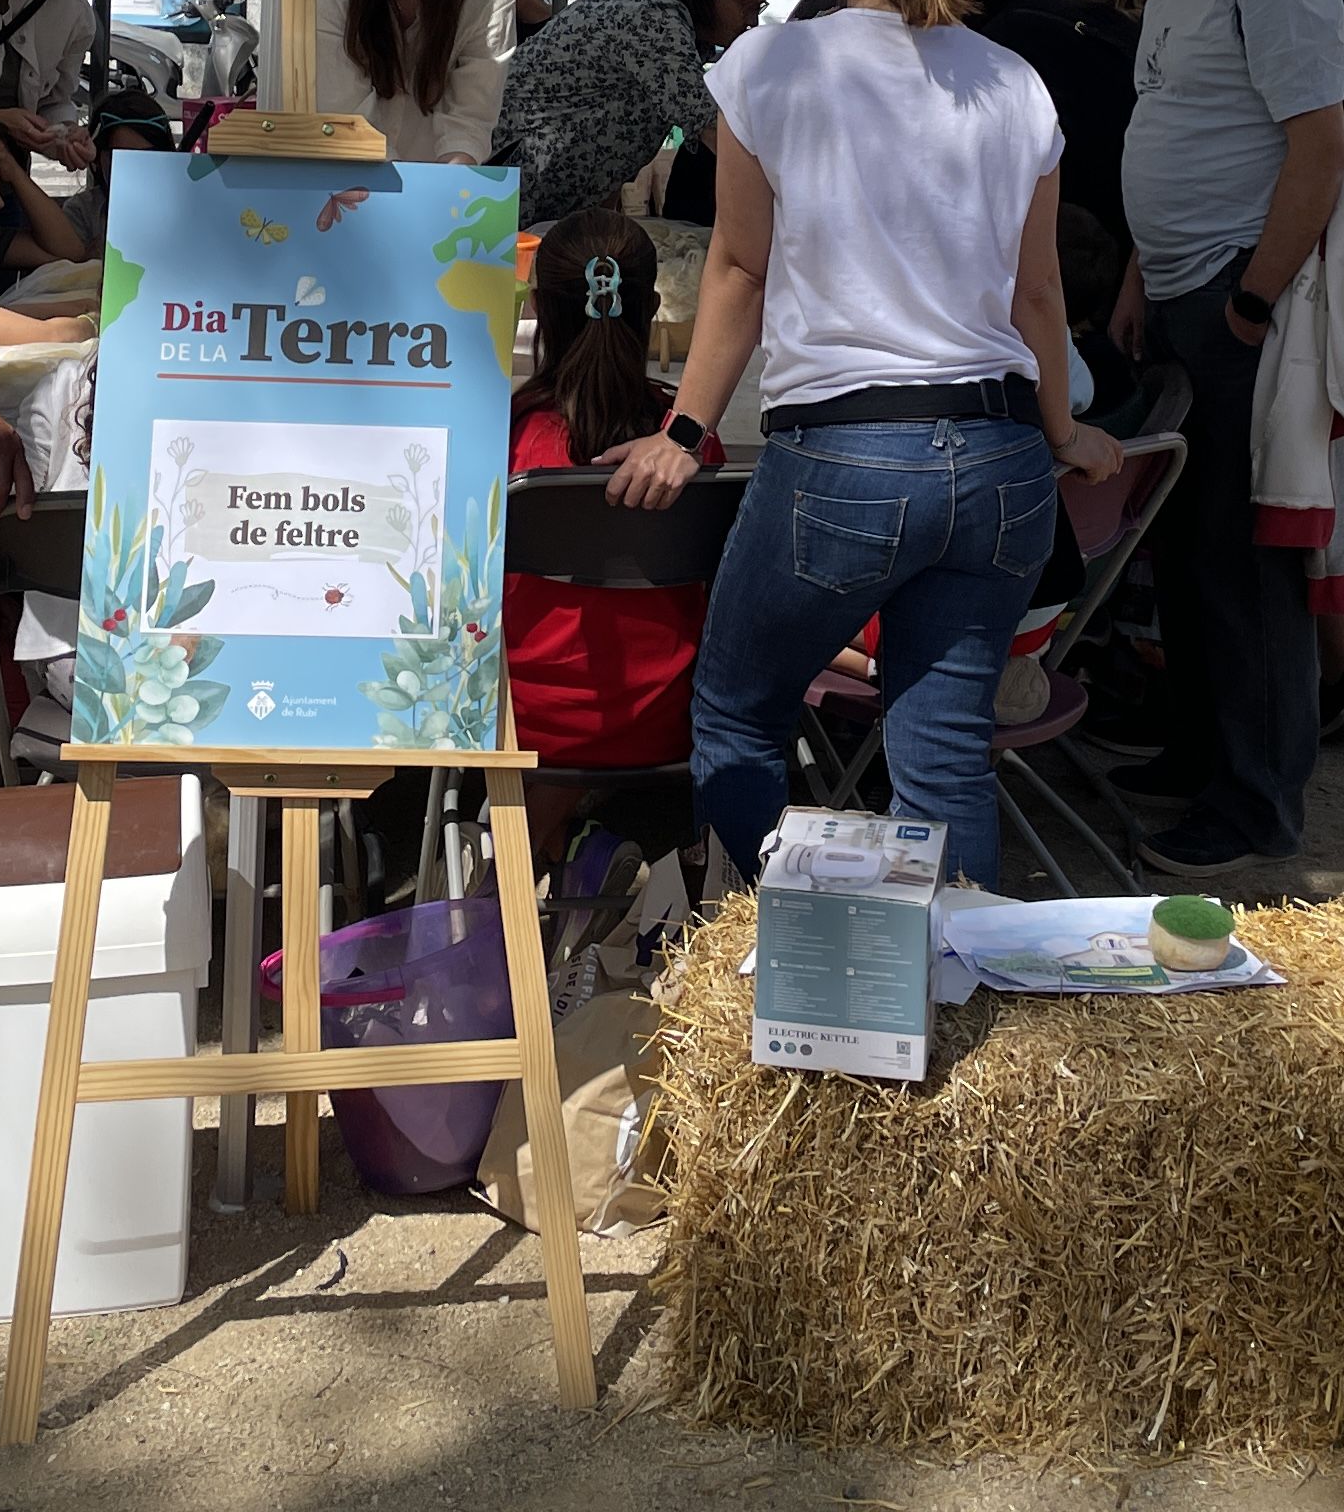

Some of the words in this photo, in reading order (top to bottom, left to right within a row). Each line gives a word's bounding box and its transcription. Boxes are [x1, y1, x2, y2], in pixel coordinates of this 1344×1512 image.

[160, 300, 229, 334] Dia
[231, 302, 453, 369] Terra
[159, 342, 192, 362] DE
[199, 343, 228, 363] LA
[227, 485, 293, 511] Fem
[301, 485, 367, 513] bols
[229, 519, 268, 546] de
[274, 520, 360, 548] feltre
[281, 707, 294, 717] de
[282, 694, 337, 706] Ajuntament
[768, 1026, 819, 1041] ELECTRIC
[820, 1031, 860, 1045] KETTLE
